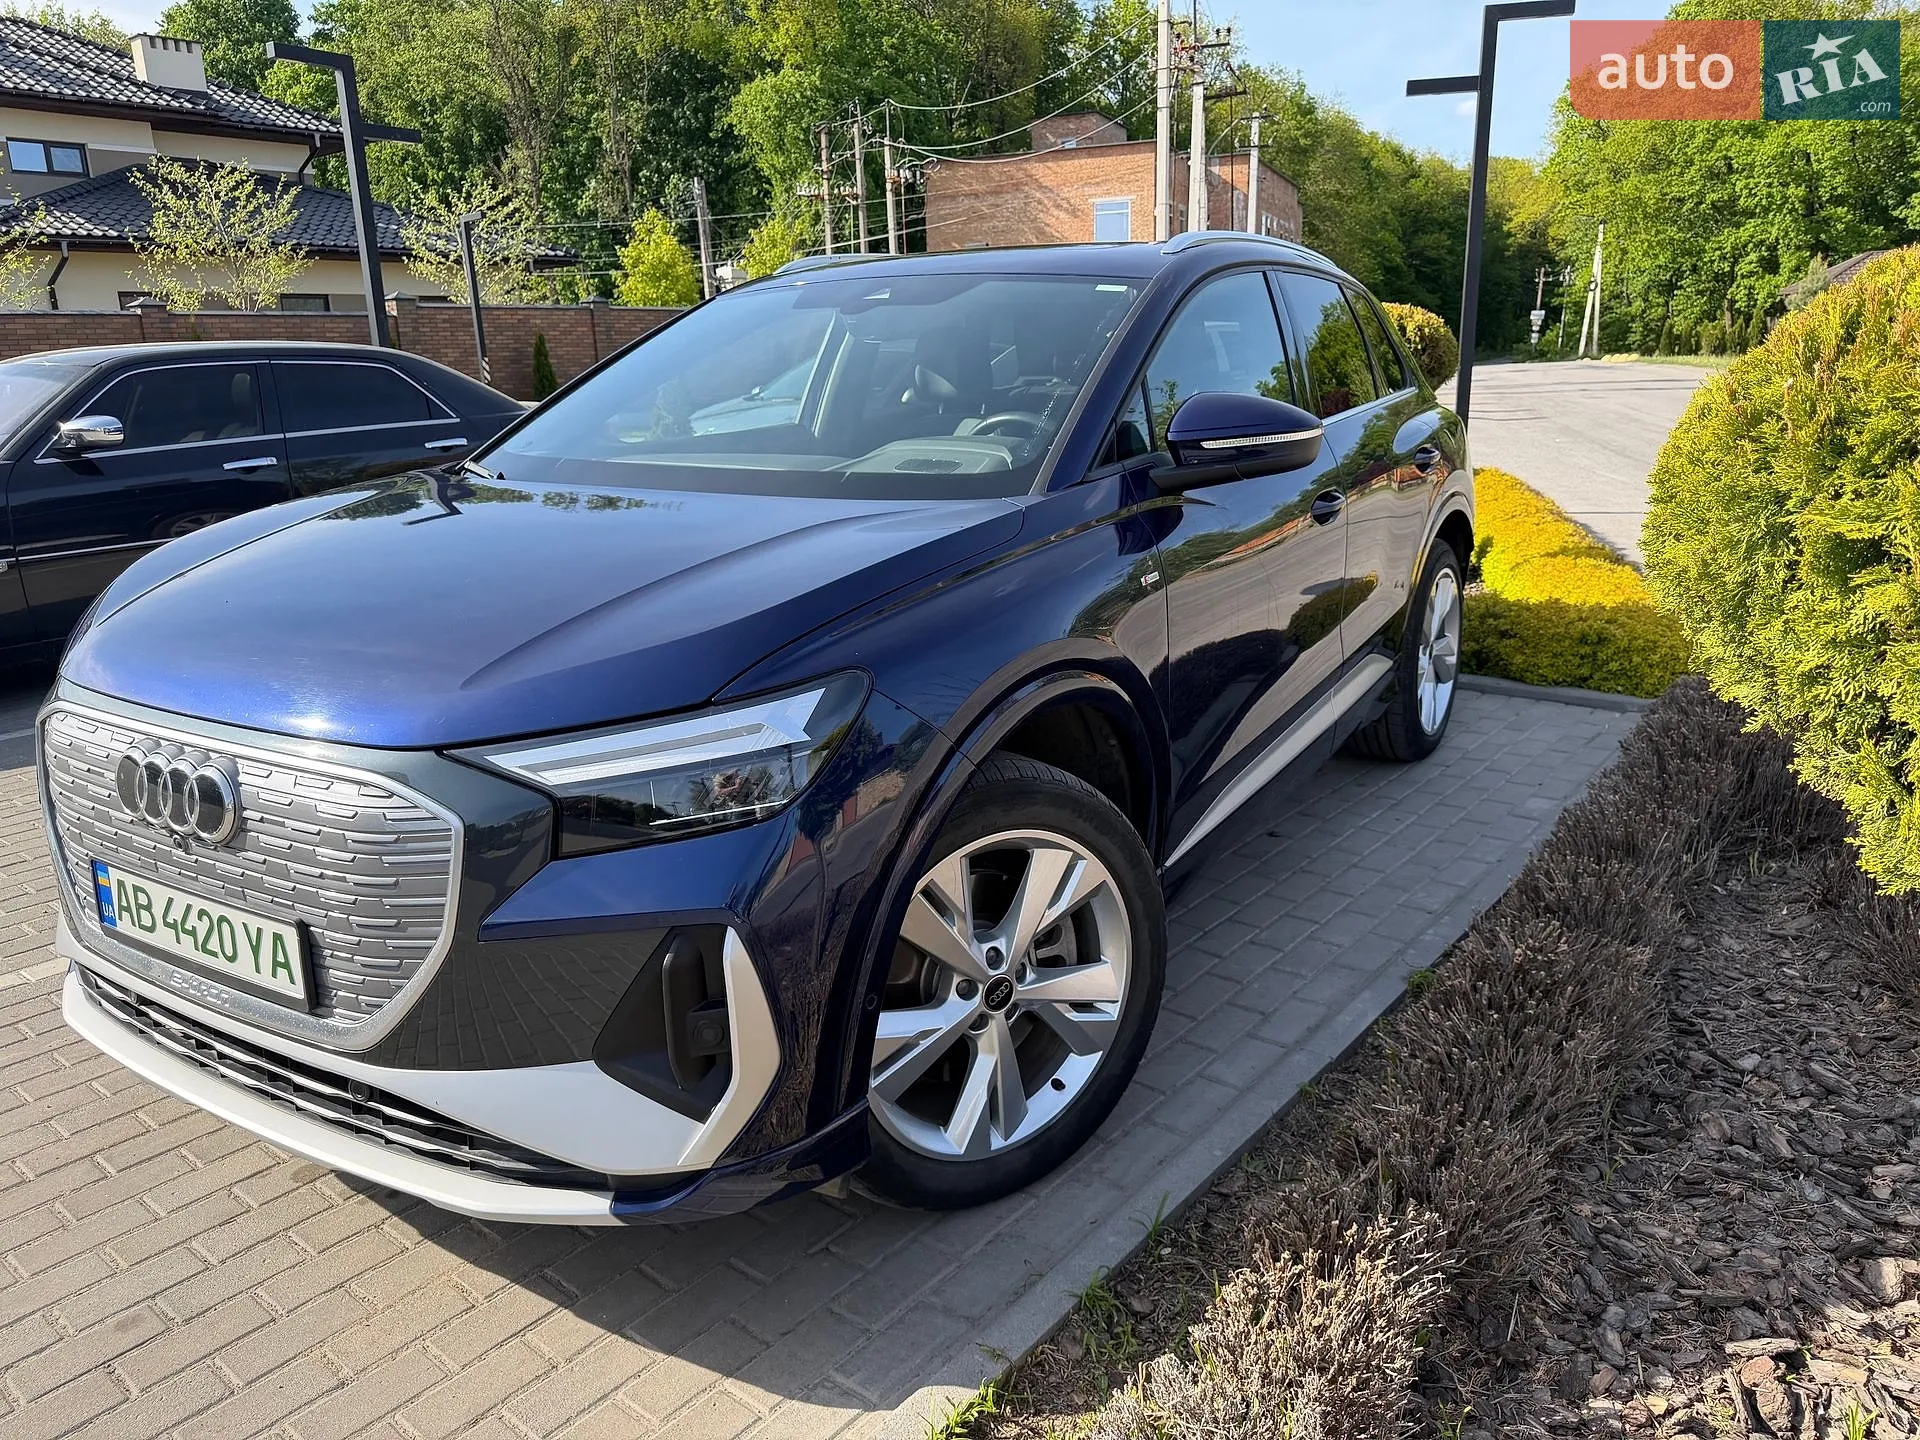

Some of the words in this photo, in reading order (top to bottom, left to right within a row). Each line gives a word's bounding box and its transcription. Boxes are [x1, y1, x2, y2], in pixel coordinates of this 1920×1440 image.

[102, 901, 116, 919] UA
[116, 878, 157, 934] AB
[161, 896, 239, 964] 4420
[242, 921, 297, 986] YA
